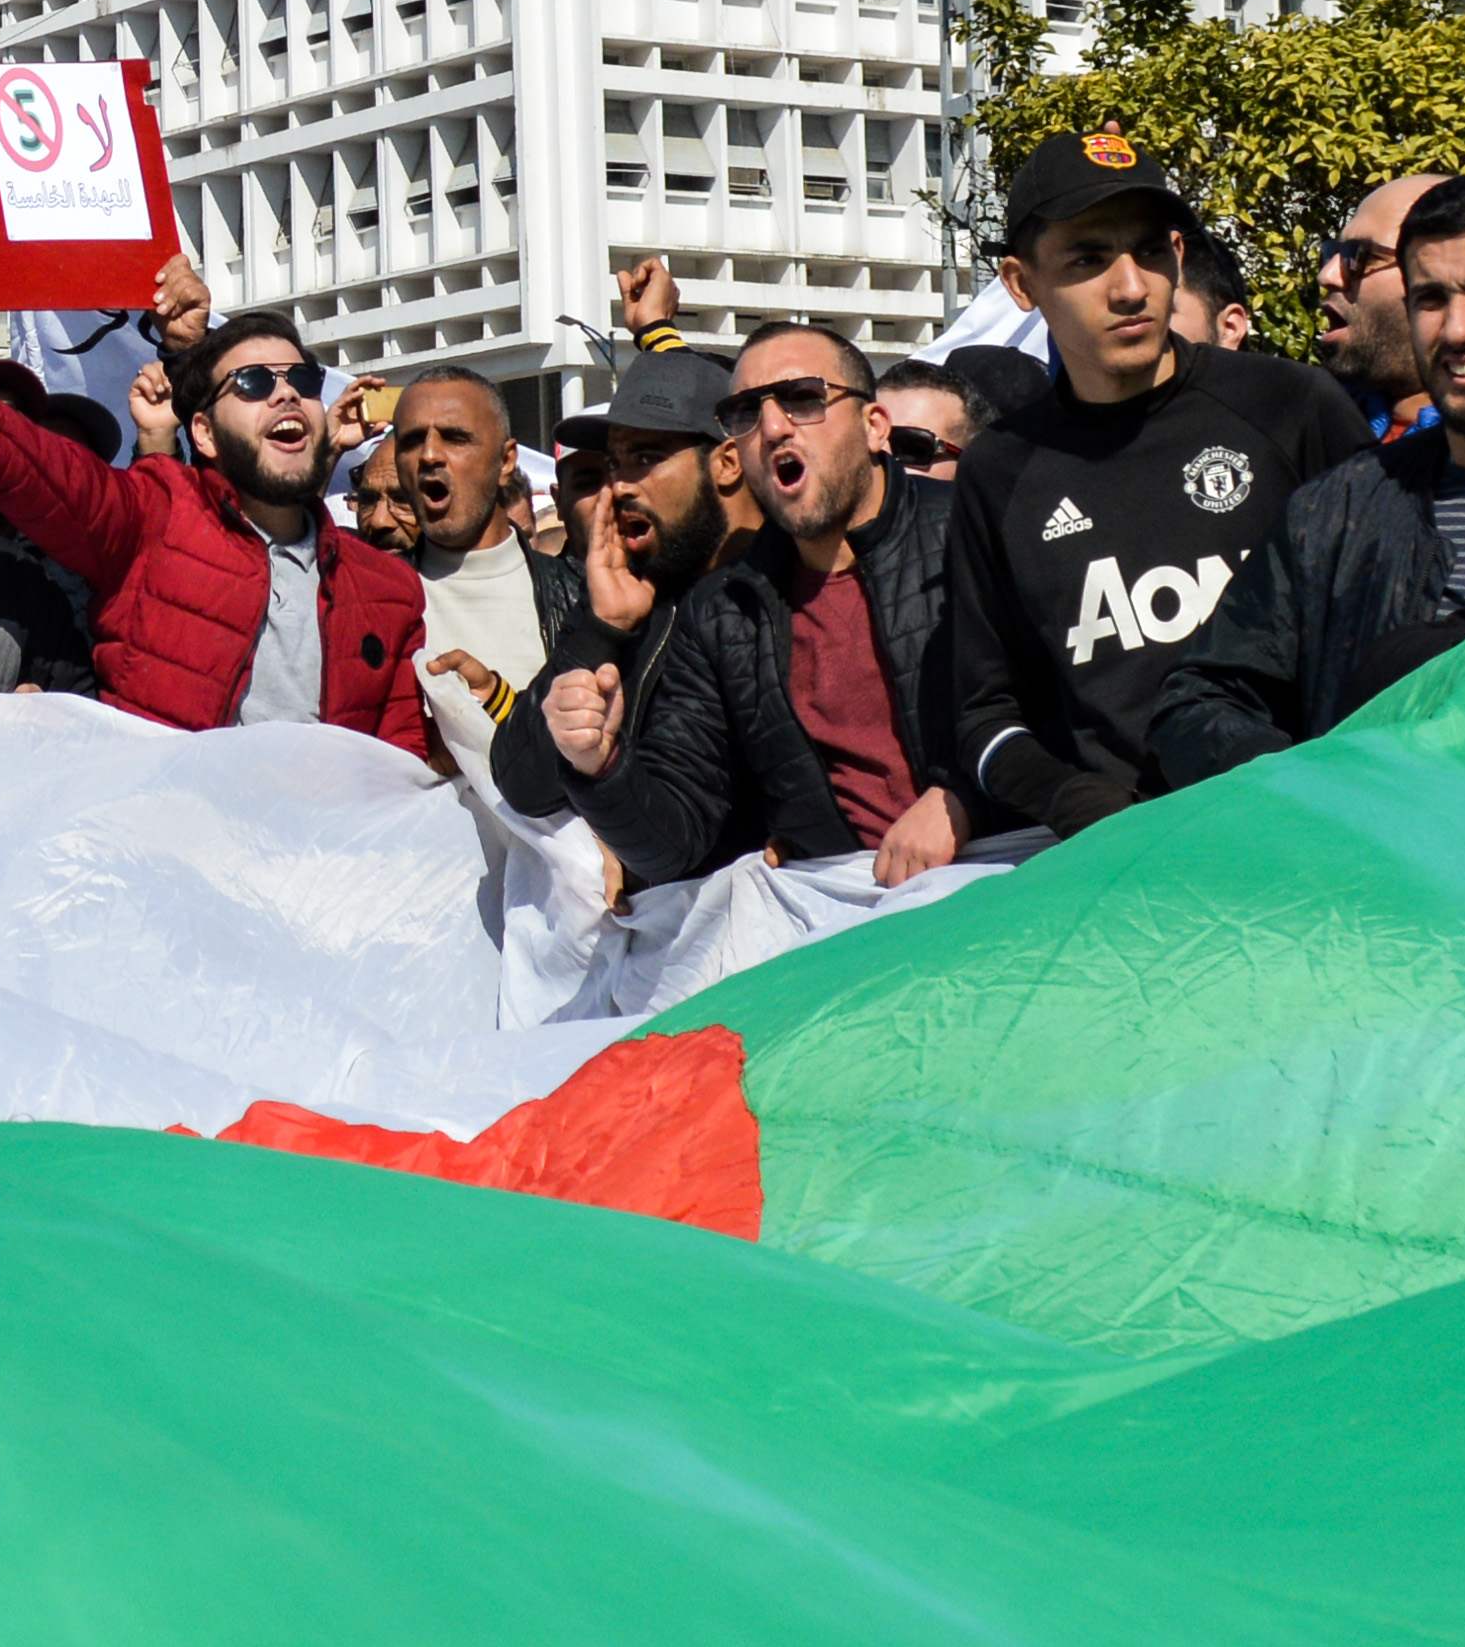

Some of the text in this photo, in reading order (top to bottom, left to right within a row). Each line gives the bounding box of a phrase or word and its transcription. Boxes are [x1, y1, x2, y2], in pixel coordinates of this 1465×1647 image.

[77, 93, 113, 172] لا
[6, 178, 134, 216] للعهدة الخامسة
[1188, 450, 1245, 477] MANCHESTER
[1202, 493, 1242, 508] UNITED
[1042, 517, 1093, 541] adidas
